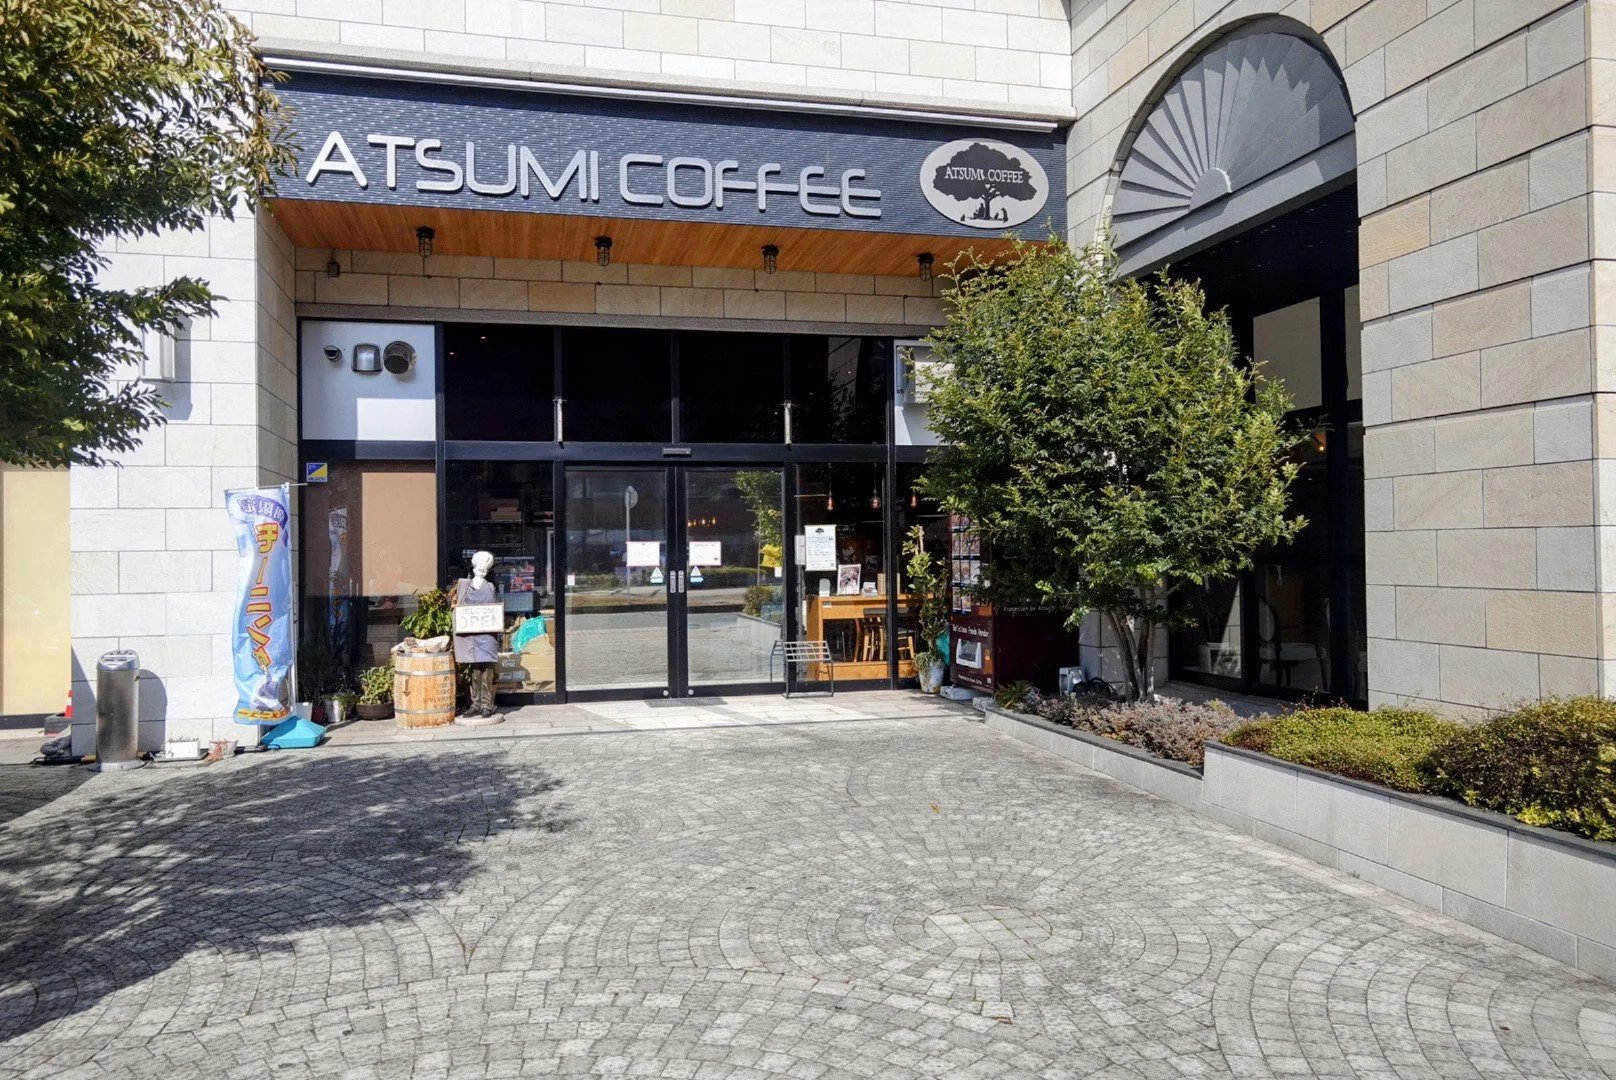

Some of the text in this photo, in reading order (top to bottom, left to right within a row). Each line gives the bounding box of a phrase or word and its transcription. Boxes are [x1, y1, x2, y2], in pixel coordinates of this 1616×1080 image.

[305, 130, 882, 218] ATSUMI COFFEE
[945, 166, 1024, 184] ATSUMI COFFEE
[460, 615, 500, 629] OPEN
